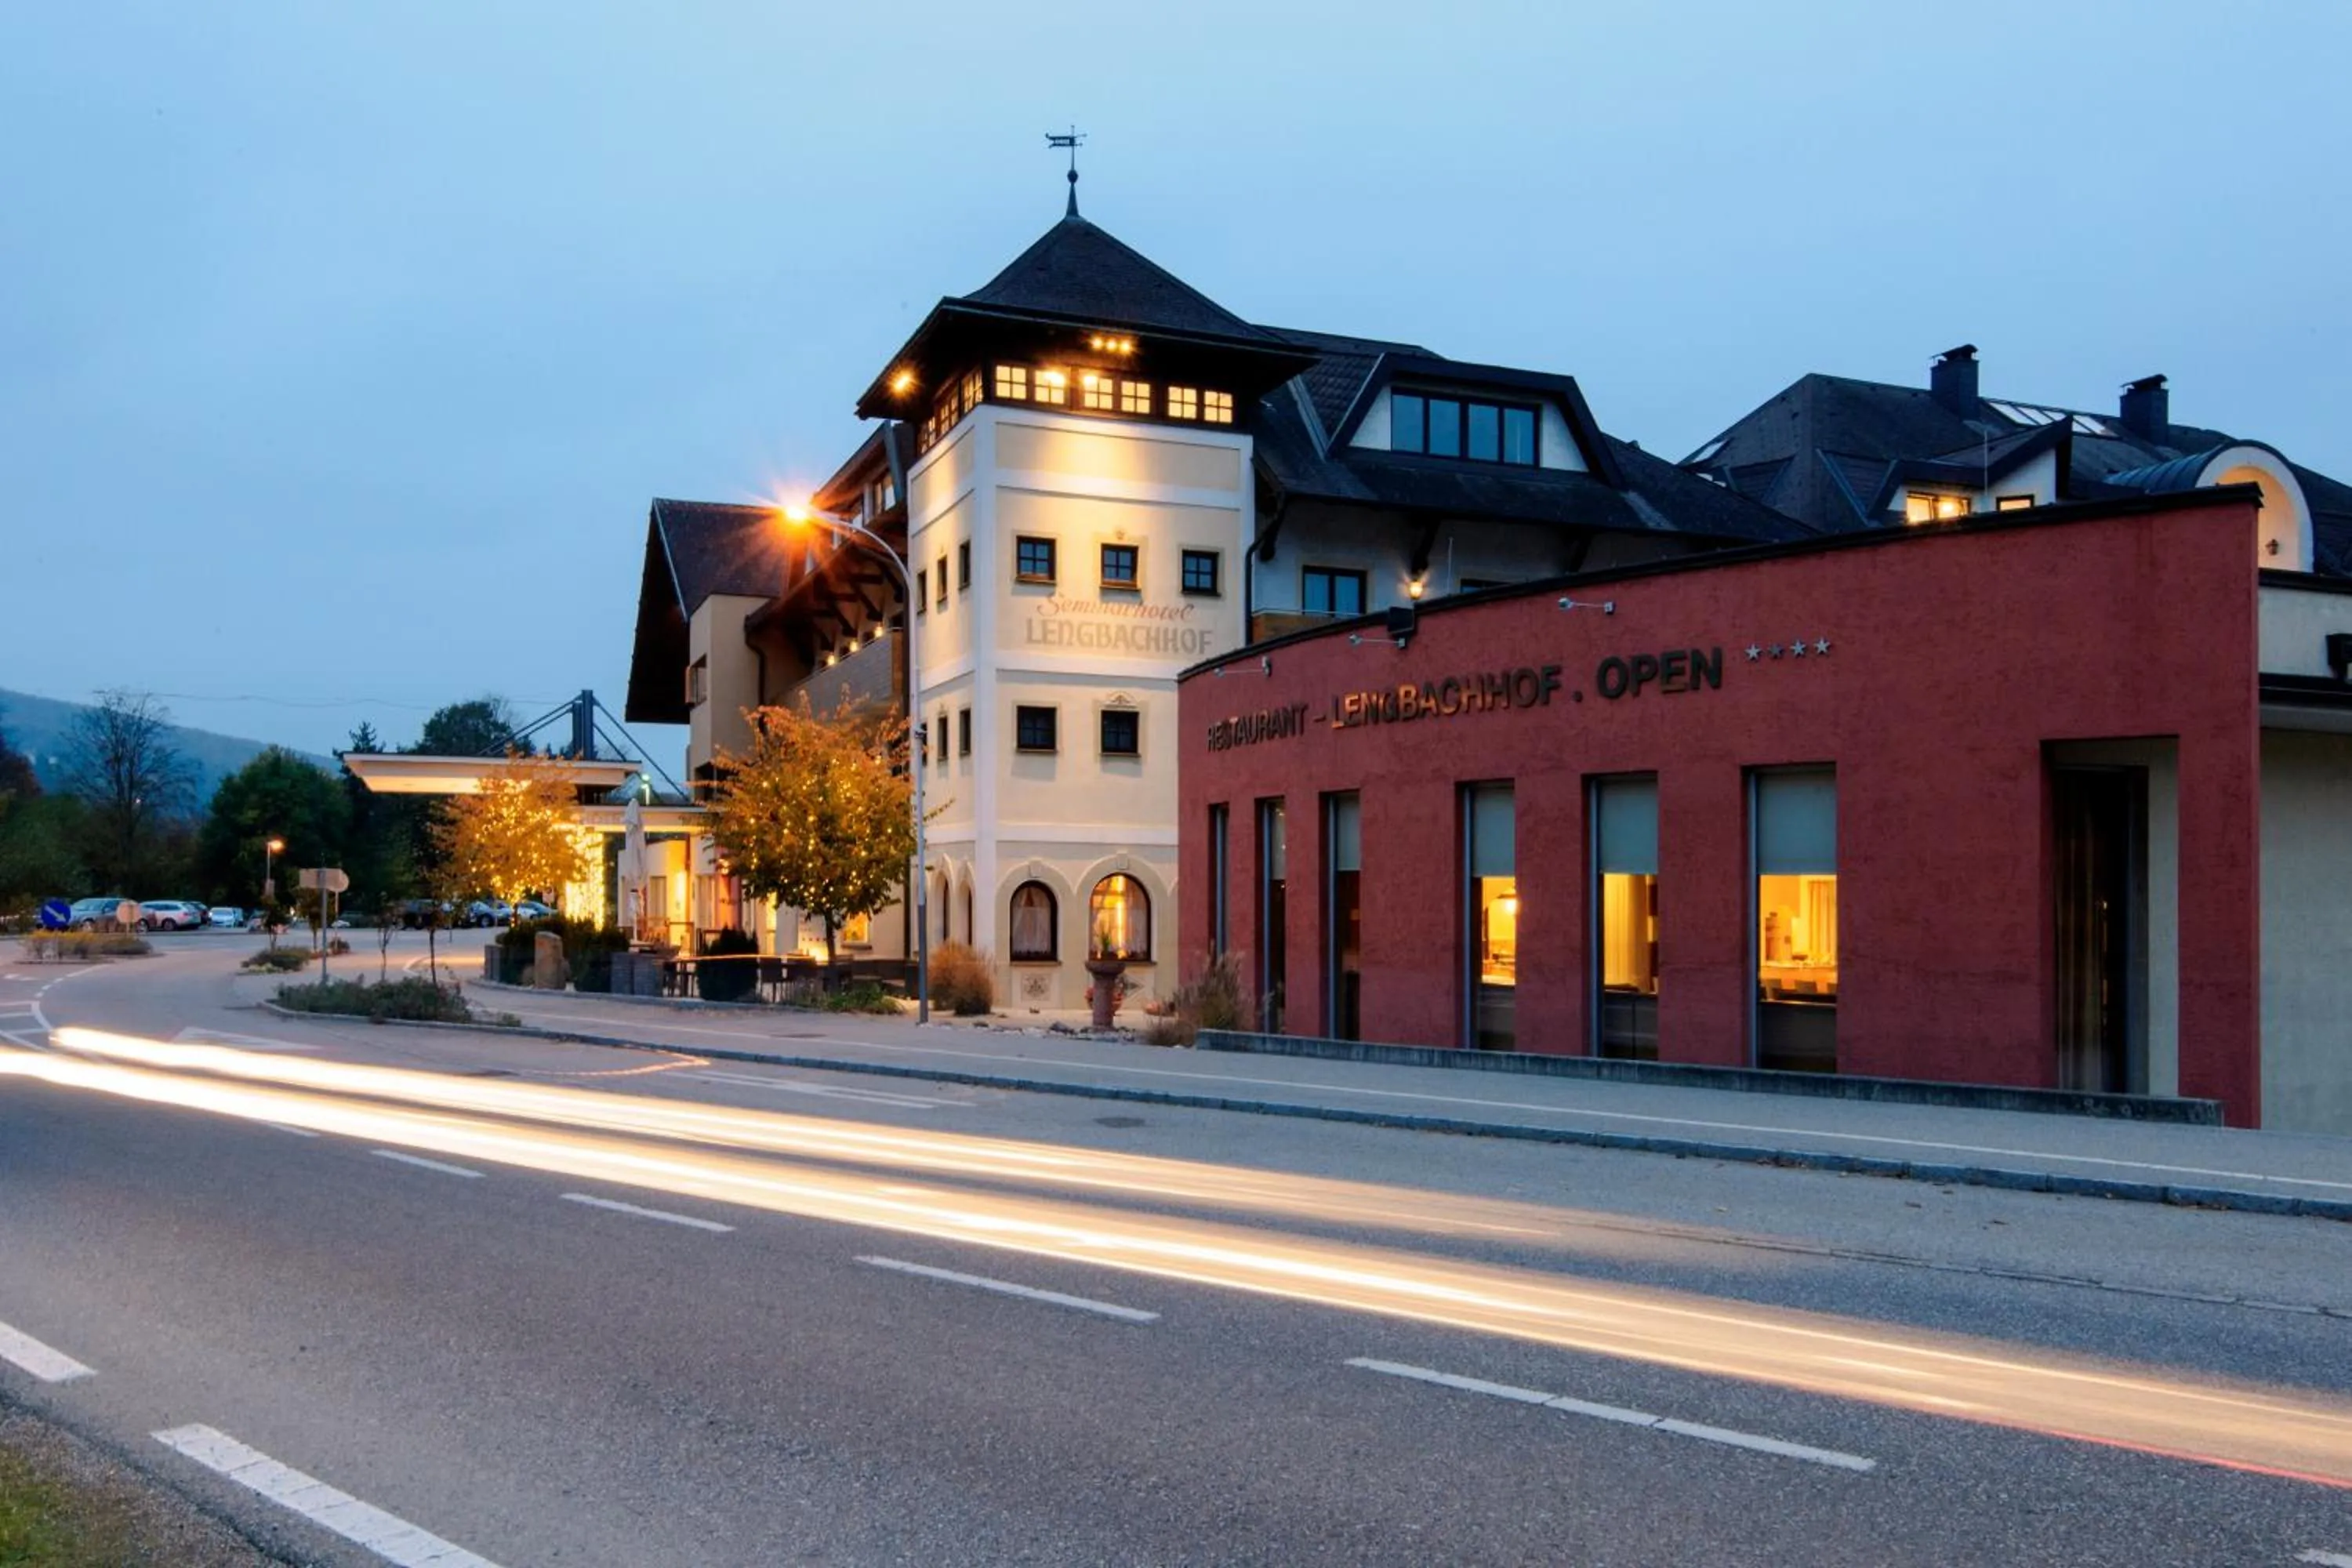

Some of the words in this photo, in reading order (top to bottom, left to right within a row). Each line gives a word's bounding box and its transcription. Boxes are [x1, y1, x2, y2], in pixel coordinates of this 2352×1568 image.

[1025, 618, 1213, 654] LENGBACHHOF
[1207, 703, 1308, 753] RESTAURANT
[1596, 646, 1722, 699] OPEN
